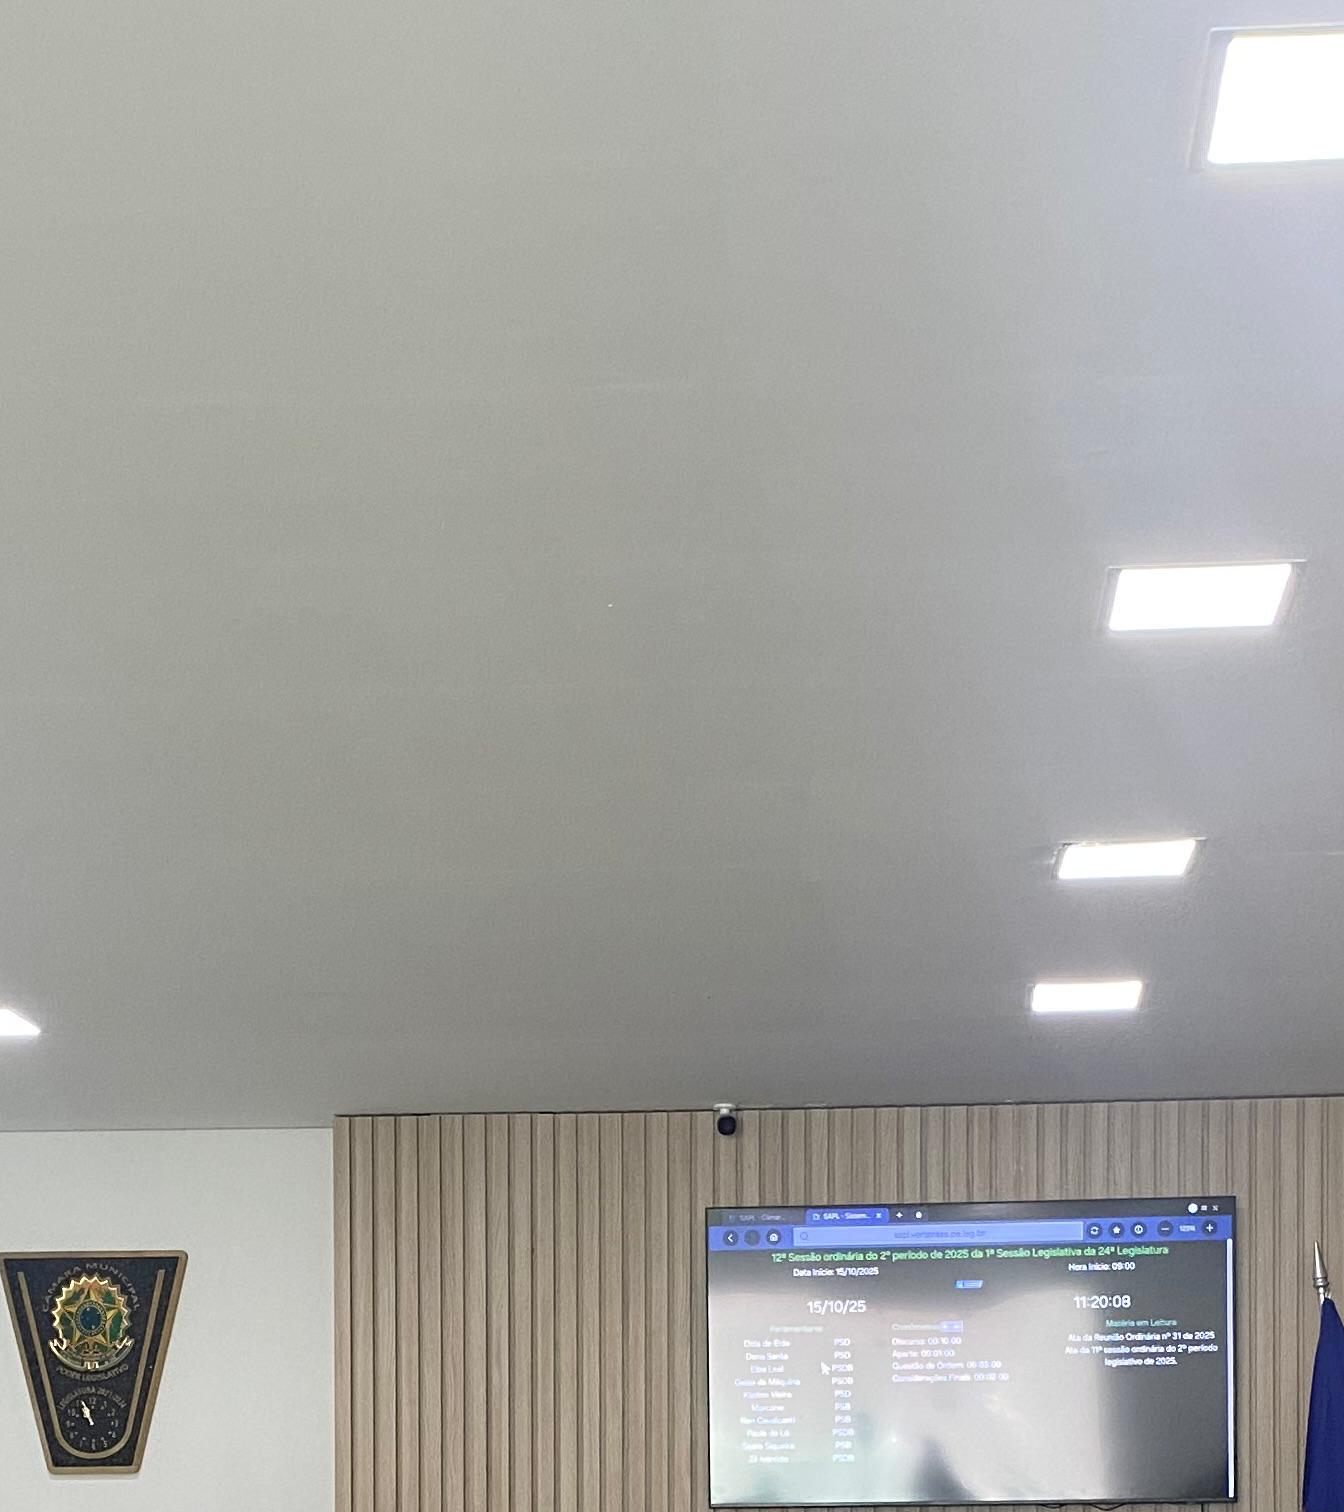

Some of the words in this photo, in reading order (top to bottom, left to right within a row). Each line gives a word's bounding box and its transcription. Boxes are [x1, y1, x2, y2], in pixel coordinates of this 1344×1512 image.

[789, 1251, 822, 1263] Sessão
[823, 1250, 864, 1262] ordinária
[866, 1251, 878, 1261] do
[930, 1249, 943, 1260] de
[944, 1249, 968, 1260] 2025
[970, 1248, 983, 1259] da
[996, 1247, 1030, 1259] Sessão
[1032, 1246, 1083, 1260] Legislativa
[1084, 1246, 1097, 1257] da
[1117, 1245, 1169, 1259] Legislatura
[1068, 1262, 1087, 1271] Hora
[1111, 1261, 1136, 1271] 09:00
[792, 1268, 811, 1277] Data
[835, 1267, 879, 1277] 15/10/2025
[85, 1262, 140, 1312] MUNICIPAL
[806, 1299, 867, 1314] 15/10/25
[1073, 1294, 1132, 1309] 11:20:08
[1150, 1318, 1178, 1327] Leitura
[1125, 1331, 1161, 1341] Ordinária
[1182, 1331, 1193, 1340] de
[1194, 1330, 1216, 1340] 2025
[833, 1338, 851, 1347] PSD
[1165, 1344, 1176, 1353] do
[833, 1351, 851, 1360] PSD
[1143, 1357, 1154, 1366] de
